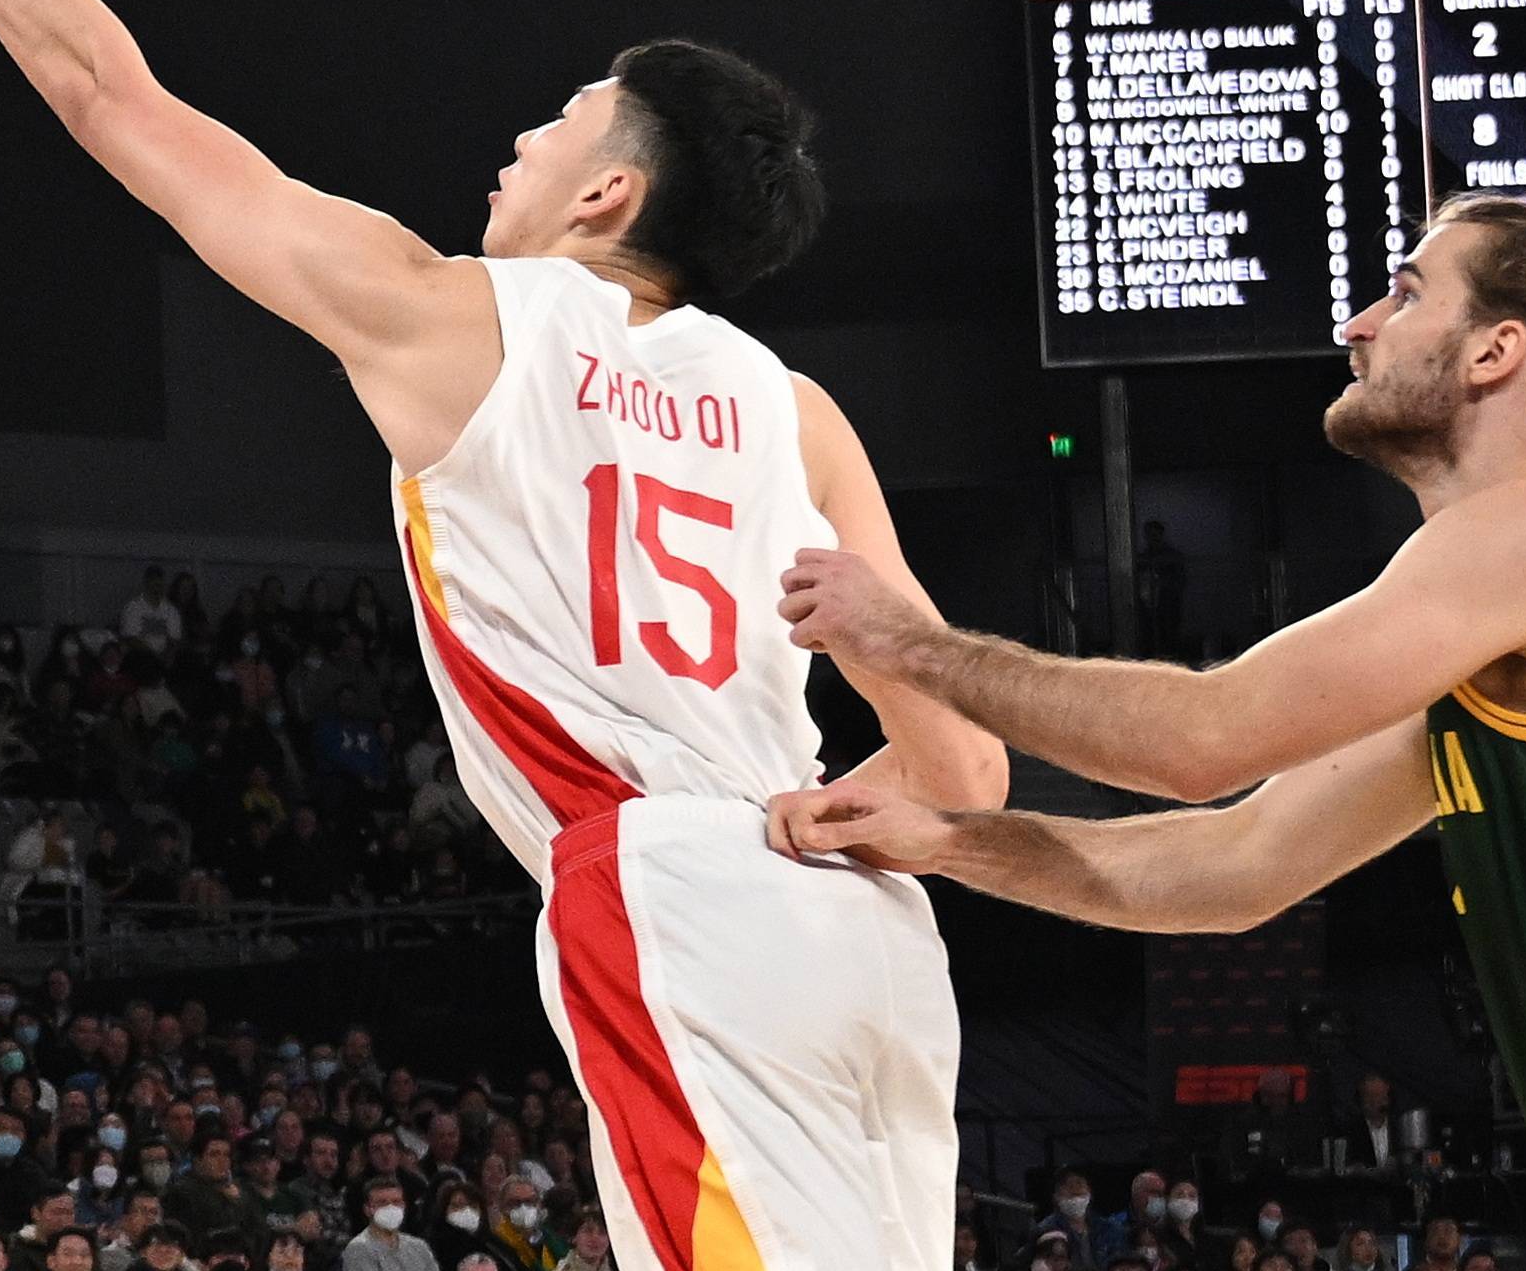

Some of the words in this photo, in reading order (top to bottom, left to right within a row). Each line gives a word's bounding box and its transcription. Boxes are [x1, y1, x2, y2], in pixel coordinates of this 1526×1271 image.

[1317, 17, 1336, 41] 0
[1374, 16, 1393, 40] 0
[1471, 21, 1499, 57] 2
[1054, 54, 1073, 77] 7
[1086, 49, 1207, 76] T.MAKER
[1318, 41, 1337, 64] 0
[1375, 40, 1395, 62] 0
[1055, 77, 1074, 101] 8
[1087, 66, 1317, 100] M.DELLAVEDOVA
[1376, 63, 1396, 86] 0
[1431, 74, 1484, 101] SHOT
[1056, 100, 1076, 123] 9
[1087, 91, 1309, 120] W.MCDOWELL-WHITE
[1321, 88, 1340, 111] 0
[1052, 121, 1086, 147] 10
[1089, 114, 1282, 147] M.MCCARRON
[1472, 113, 1497, 147] 8
[1053, 146, 1086, 171] 12
[1091, 137, 1306, 171] T.BLANCHFIELD
[1324, 158, 1344, 181] 0
[1381, 155, 1401, 178] 0
[1053, 170, 1089, 194] 13
[1093, 164, 1245, 194] S.FROLING
[1055, 194, 1089, 218] 14
[1094, 190, 1208, 218] J.WHITE
[1055, 217, 1089, 242] 22
[1095, 210, 1248, 241] J.MCVEIGH
[1328, 229, 1347, 253] 0
[1385, 228, 1405, 252] 0
[1056, 241, 1091, 267] 23
[1096, 236, 1229, 263] K.PINDER
[1329, 254, 1349, 276] 0
[1057, 266, 1092, 290] 30
[1098, 256, 1268, 287] S.MCDANIEL
[1058, 288, 1094, 314] 35
[1098, 282, 1246, 312] C.STEINDL
[1330, 277, 1350, 300] 0
[1331, 300, 1351, 322] 0
[576, 351, 682, 441] ZHOU
[696, 394, 740, 453] QI
[581, 463, 738, 691] 15
